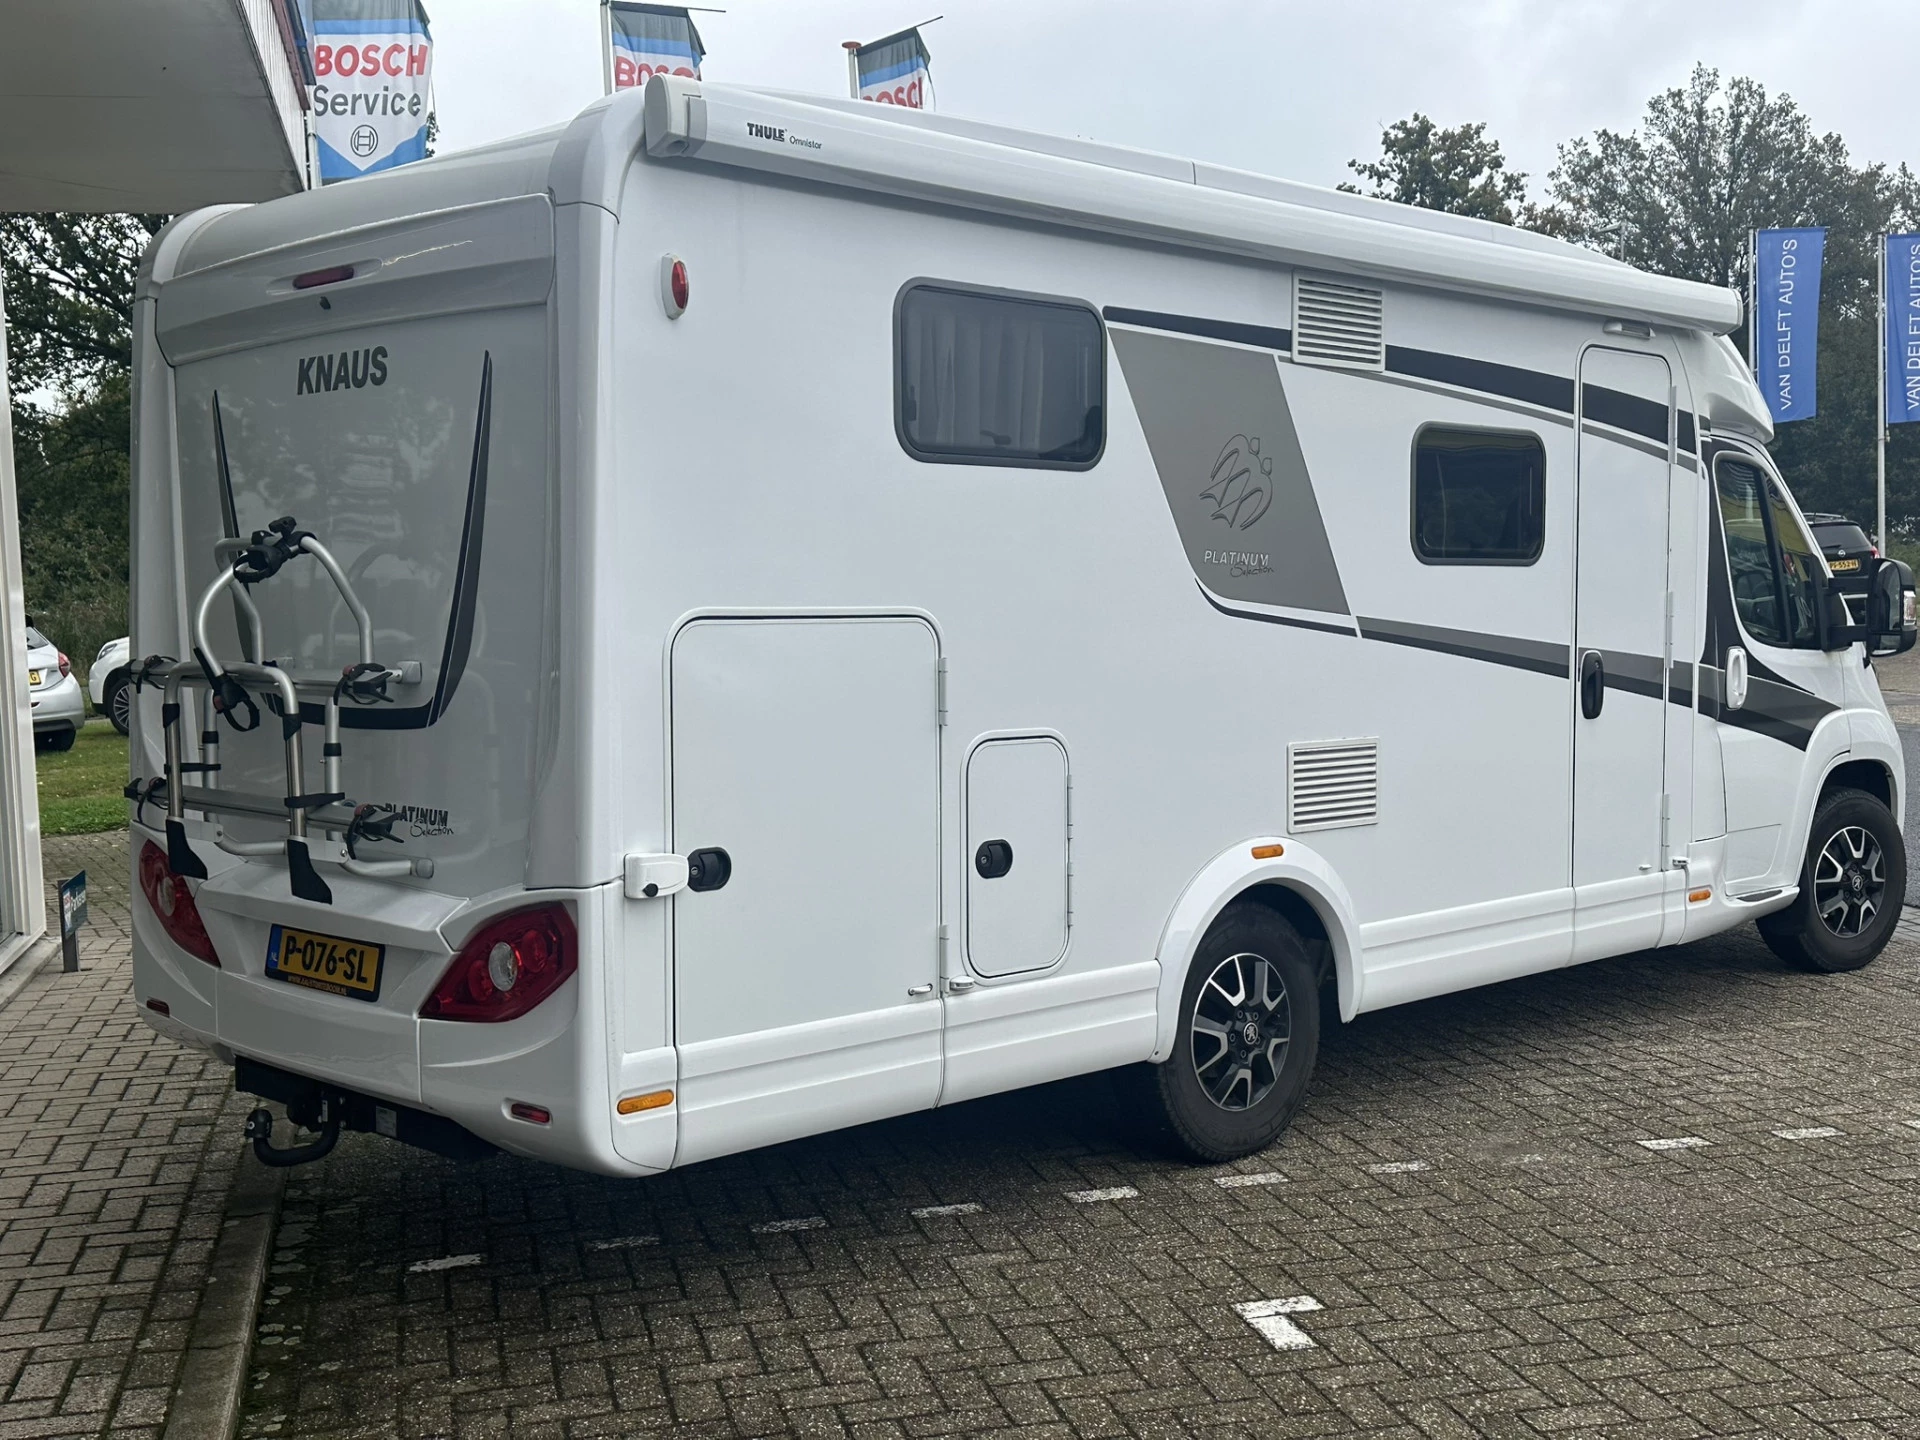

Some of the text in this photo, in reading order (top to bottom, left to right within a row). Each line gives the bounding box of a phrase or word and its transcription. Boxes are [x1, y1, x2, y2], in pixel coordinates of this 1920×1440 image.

[315, 44, 428, 77] BOSCH
[313, 84, 421, 117] Service
[746, 122, 822, 149] THULE Omnistor
[1777, 239, 1798, 410] VAN DELFT AUTO'S
[297, 345, 388, 396] KNAUS
[1907, 376, 1920, 411] VAN
[1204, 550, 1270, 567] PLATINUM
[1230, 562, 1275, 578] Selection
[410, 818, 455, 838] Selection
[284, 936, 367, 983] P-076-SL
